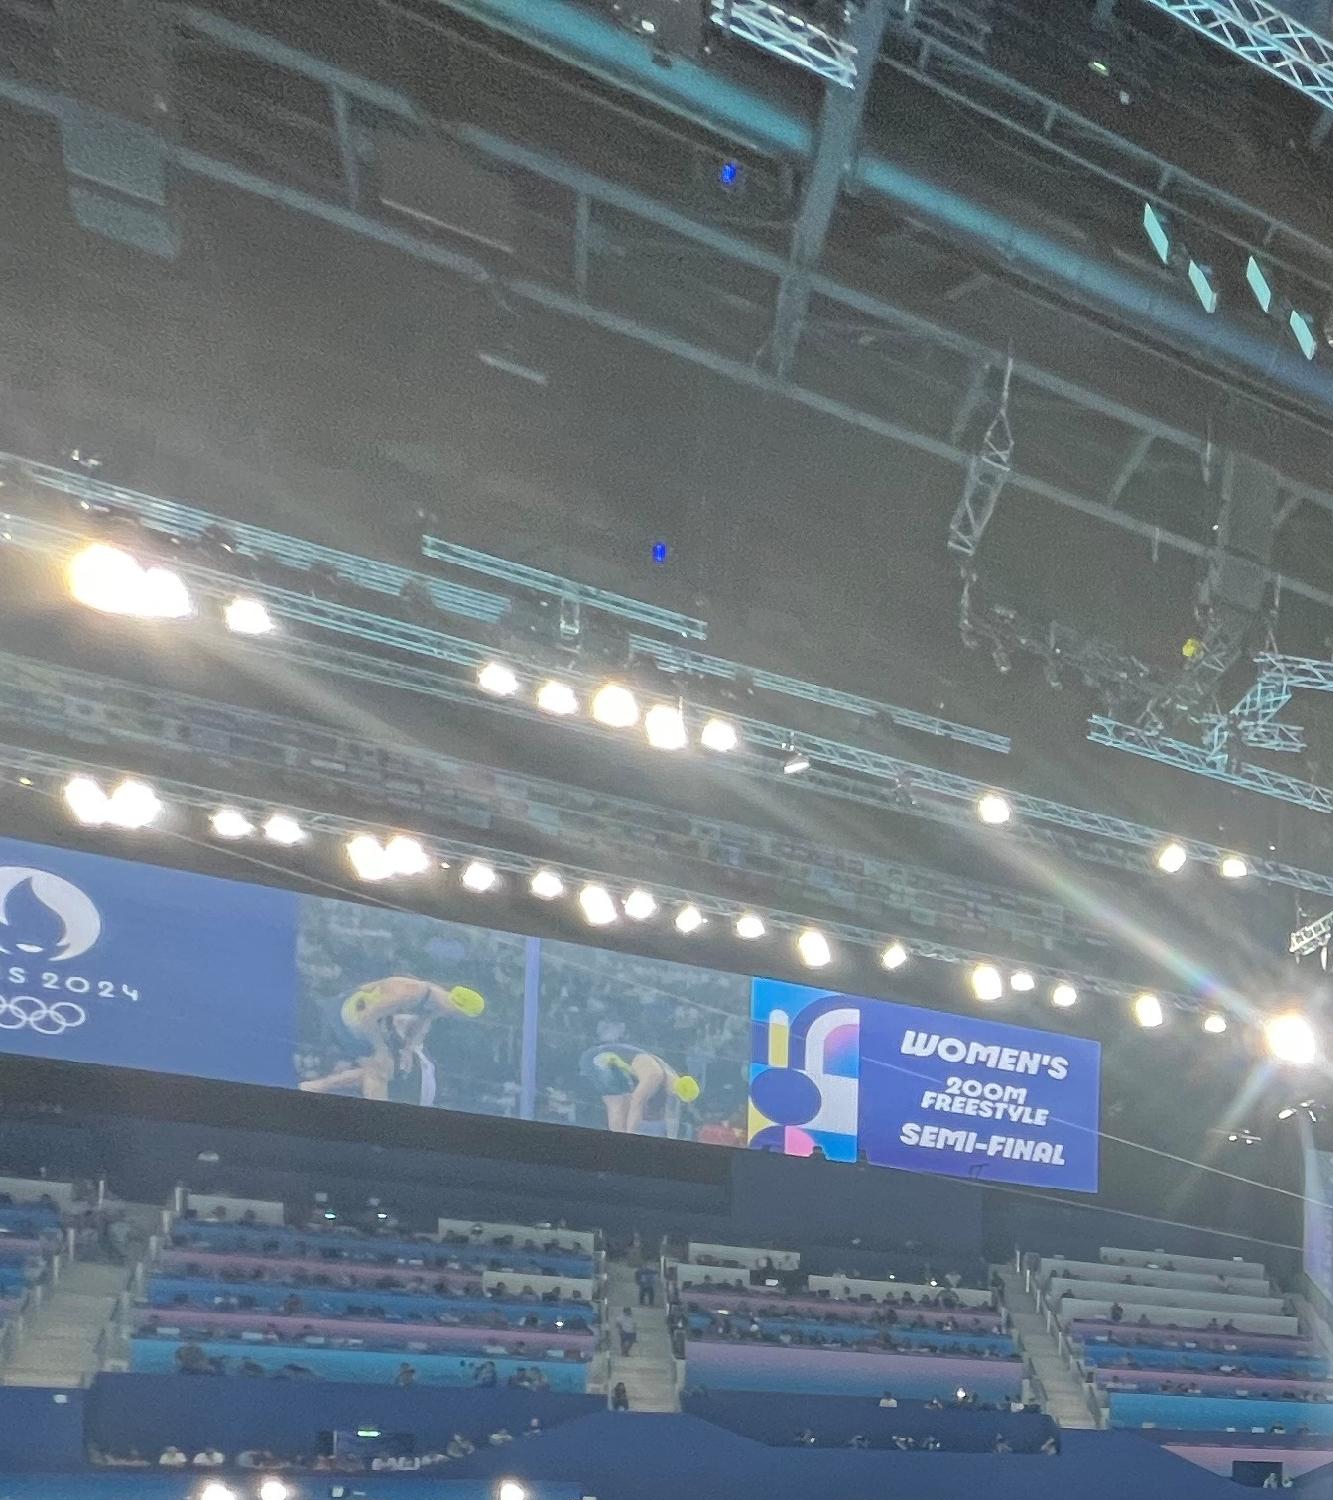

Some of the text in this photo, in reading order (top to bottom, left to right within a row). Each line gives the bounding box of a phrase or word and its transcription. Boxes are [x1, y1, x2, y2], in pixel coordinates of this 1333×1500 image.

[42, 971, 139, 1001] 2024
[901, 1030, 1069, 1079] WOMEN'S
[920, 1090, 1050, 1126] FREESTYLE
[945, 1076, 1028, 1105] 200M
[899, 1122, 1066, 1166] SEMI-FINAL
